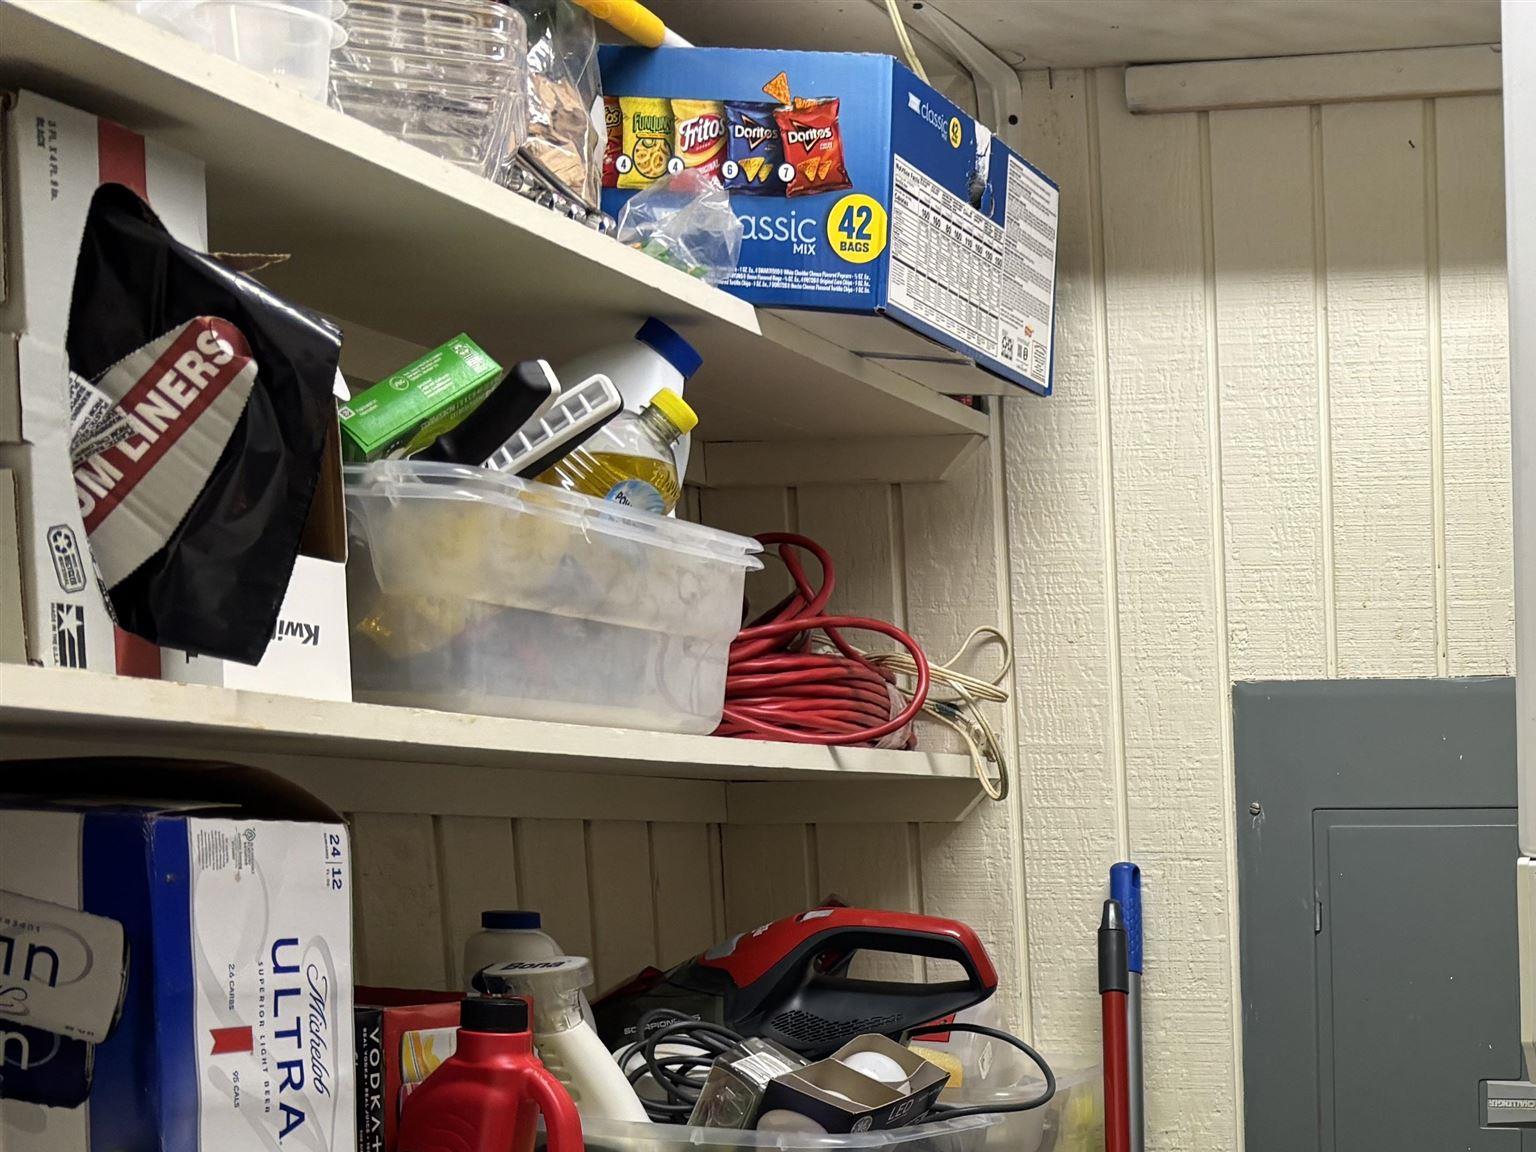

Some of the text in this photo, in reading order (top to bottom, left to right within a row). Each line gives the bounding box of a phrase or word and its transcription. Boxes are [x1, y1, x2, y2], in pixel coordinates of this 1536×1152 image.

[920, 102, 949, 135] classic
[679, 115, 726, 152] Fritos
[735, 124, 778, 140] Doritos
[788, 126, 832, 144] Doritos
[620, 158, 627, 169] 4
[673, 161, 679, 171] 4
[726, 162, 733, 174] 6
[783, 168, 790, 178] 7
[737, 210, 817, 242] assic
[838, 205, 873, 241] 42
[793, 243, 816, 256] MIX
[840, 241, 870, 253] BAGS
[119, 329, 235, 463] LINERS
[329, 834, 341, 858] 24
[331, 868, 342, 890] 12
[501, 961, 565, 971] Bona
[228, 982, 236, 1011] CARBS
[257, 961, 266, 1027] SUPERIOR
[271, 937, 306, 1139] ULTRA
[307, 963, 330, 1098] Michelob
[260, 1035, 268, 1073] LIGHT
[232, 1070, 239, 1083] 95
[887, 1099, 914, 1121] LED
